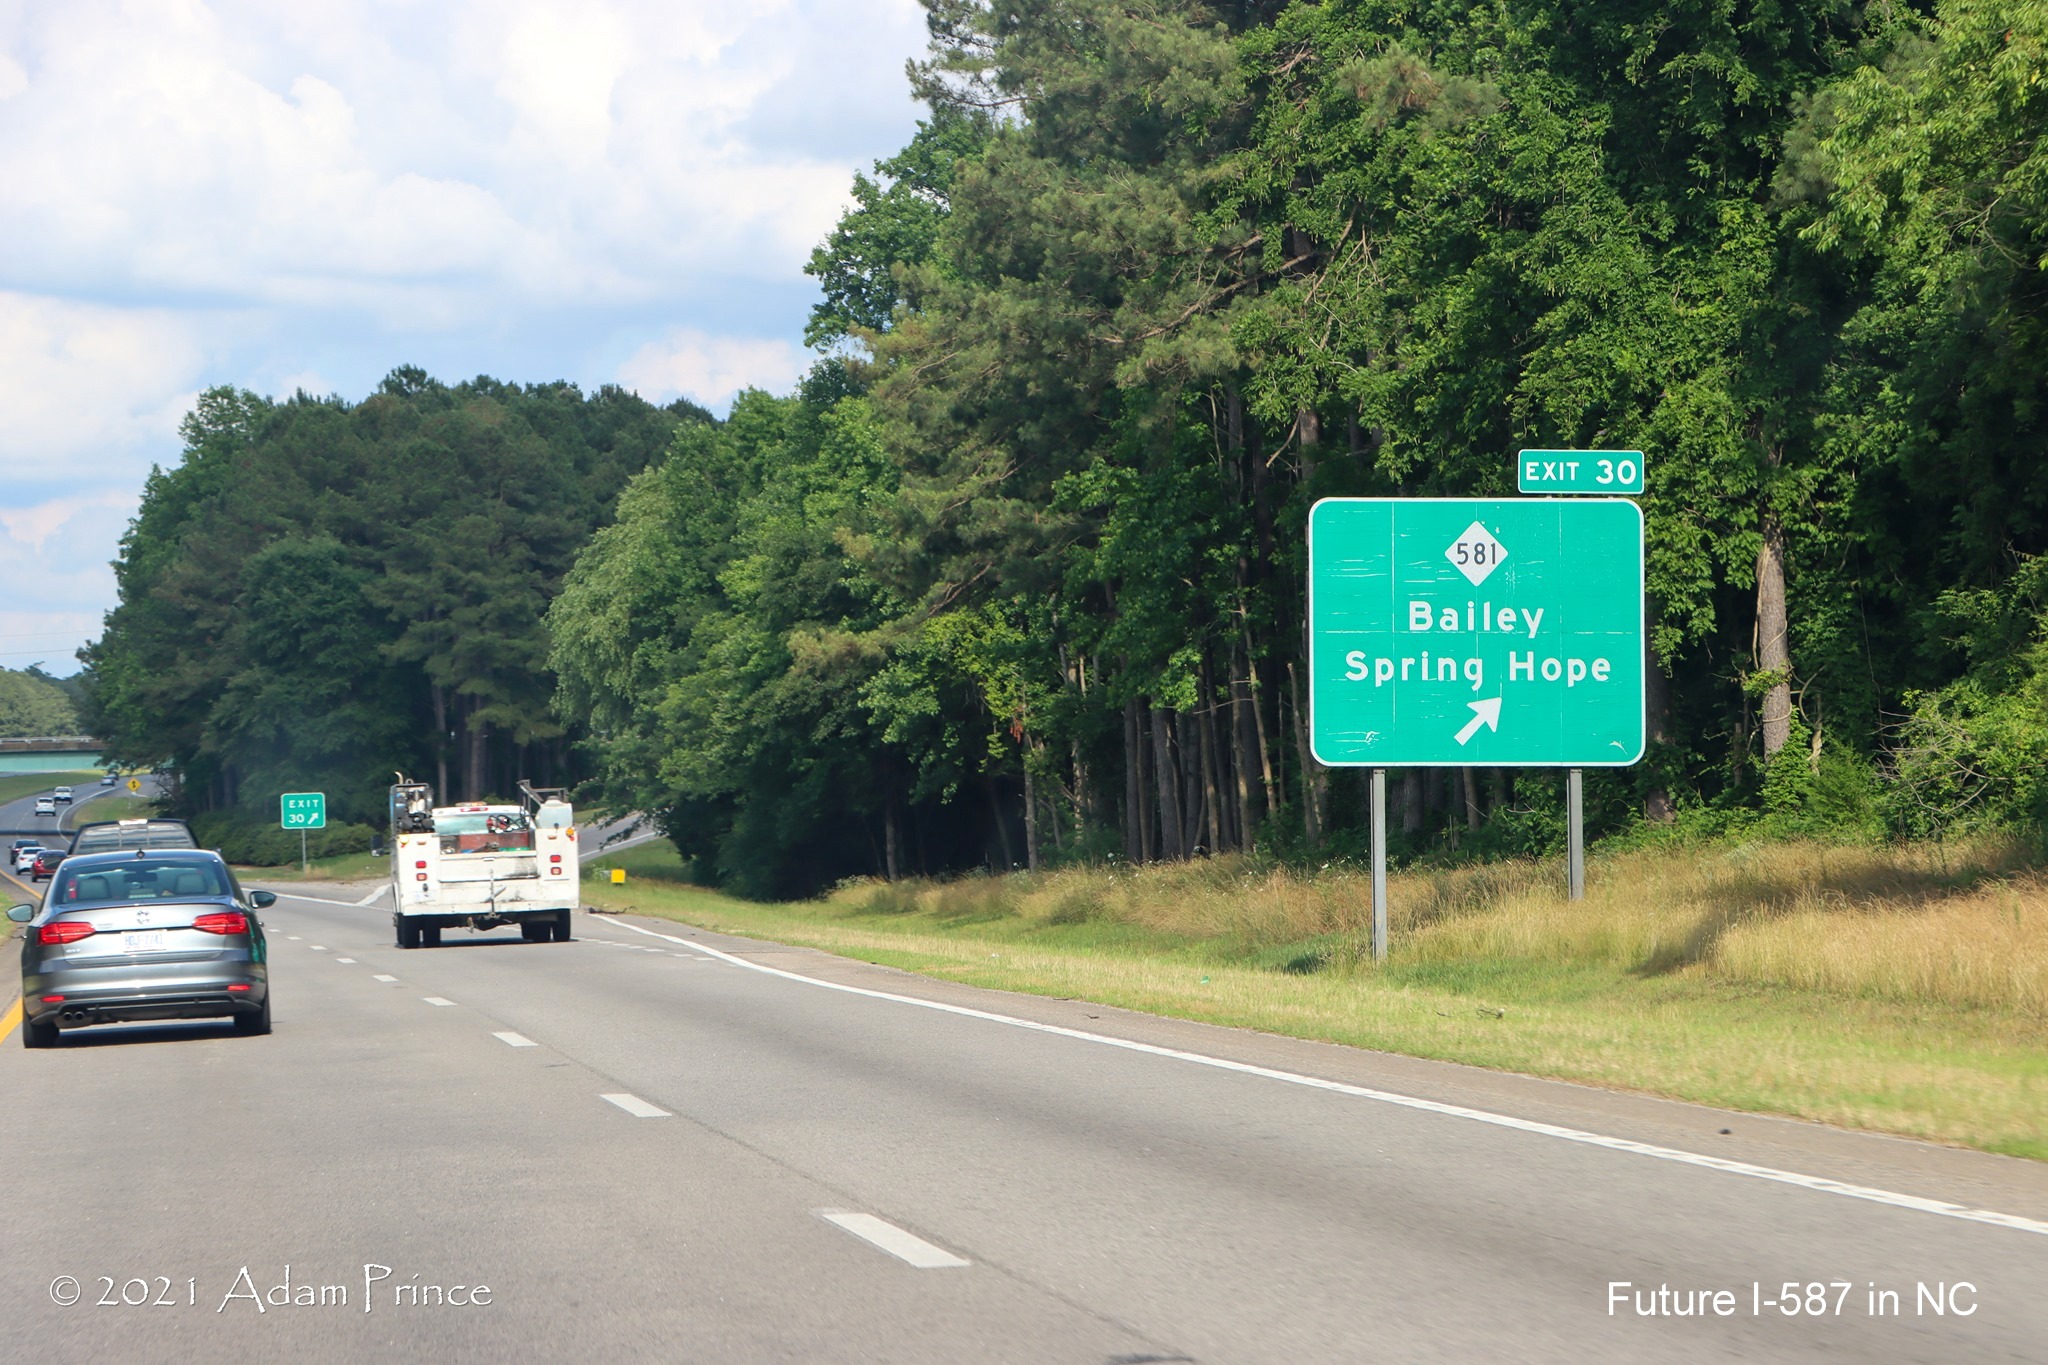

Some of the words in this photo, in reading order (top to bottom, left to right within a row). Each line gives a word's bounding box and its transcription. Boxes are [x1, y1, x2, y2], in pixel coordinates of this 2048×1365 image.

[1525, 461, 1580, 481] EXIT
[1595, 460, 1637, 485] 30
[1456, 542, 1497, 565] 581
[1409, 601, 1544, 639] Bailey
[1345, 650, 1484, 691] Spring
[1509, 651, 1611, 687] Hope
[289, 799, 319, 809] EXIT
[288, 813, 305, 824] 30
